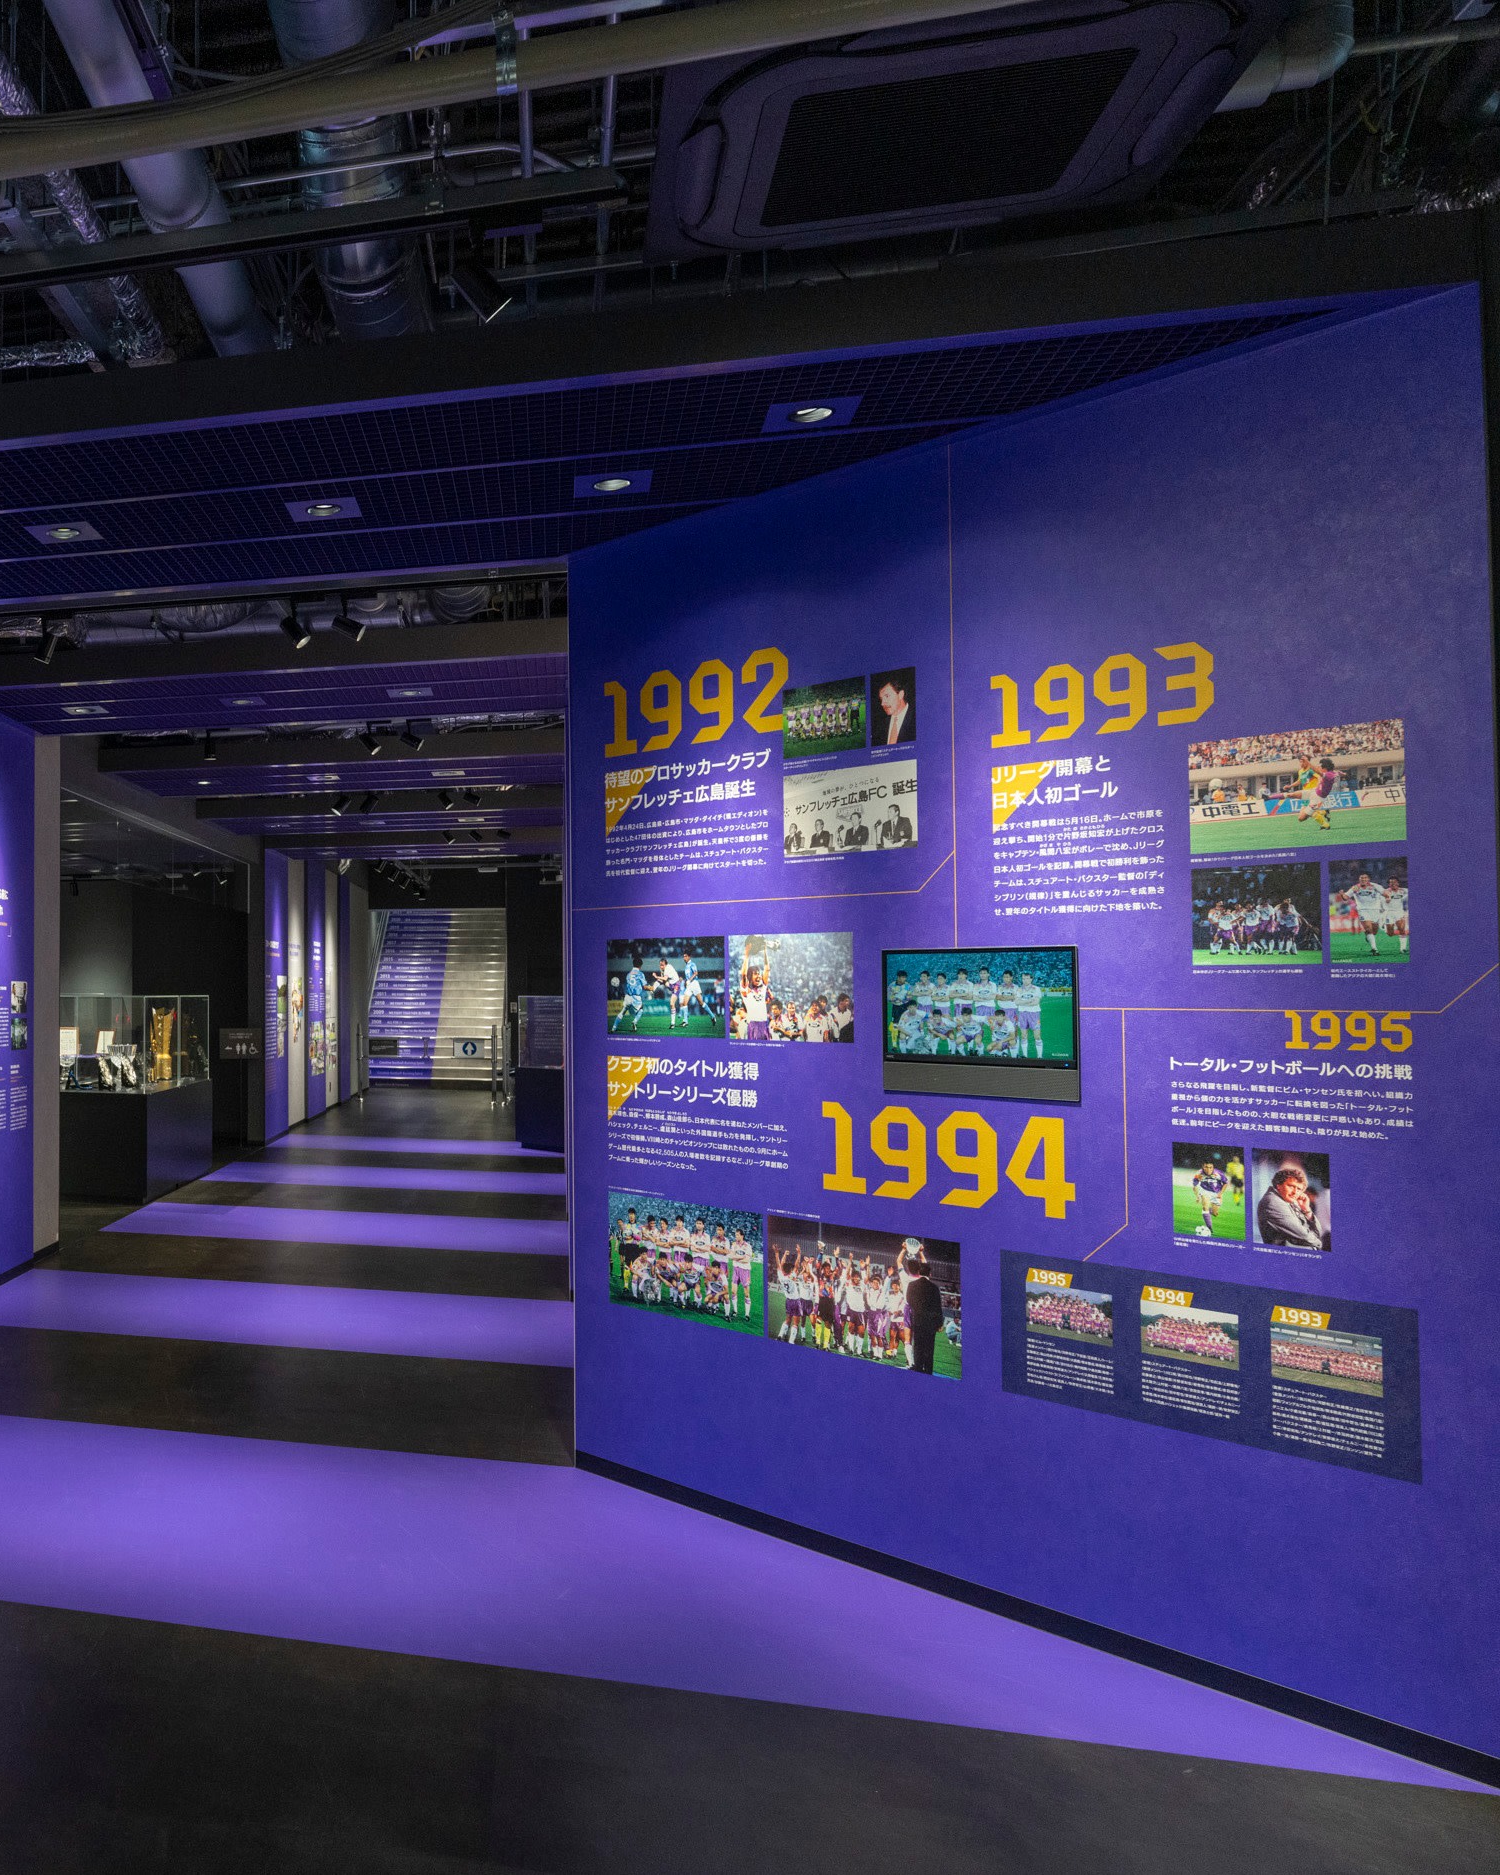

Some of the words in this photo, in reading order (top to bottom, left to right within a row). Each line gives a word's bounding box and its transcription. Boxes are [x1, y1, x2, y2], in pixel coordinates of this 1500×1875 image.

[604, 646, 789, 758] 1992
[990, 642, 1214, 748] 1993
[605, 748, 771, 789] 待望のプロサッカークラブ
[991, 755, 1111, 784] Jリーグ開幕と
[605, 779, 756, 813] サンフレッチェ広島誕生
[795, 785, 887, 815] サンフレッチェ広島FC
[892, 779, 917, 796] 誕生
[991, 781, 1118, 809] 日本人初ゴール
[1202, 802, 1260, 818] 中電工
[1284, 1010, 1412, 1052] 1995
[607, 1056, 759, 1080] クラブ初のタイトル獲得
[1170, 1056, 1412, 1080] トータル・フットボールへの挑戦
[608, 1083, 758, 1108] サントリーシリーズ優勝
[1171, 1081, 1413, 1100] さらなる飛躍を目指し、新監督にビム・ヤンセン氏を招へい。組織力
[1171, 1094, 1413, 1113] 重視から個の力を活かすサッカーに転換を図った「トータル・フット
[1172, 1106, 1414, 1128] ボール」を目指したものの、大胆な戦術変更に戸惑いもあり、成績は
[822, 1101, 1075, 1219] 1994
[1032, 1270, 1066, 1286] 1995
[1149, 1288, 1185, 1306] 1994
[1280, 1308, 1322, 1327] 1993
